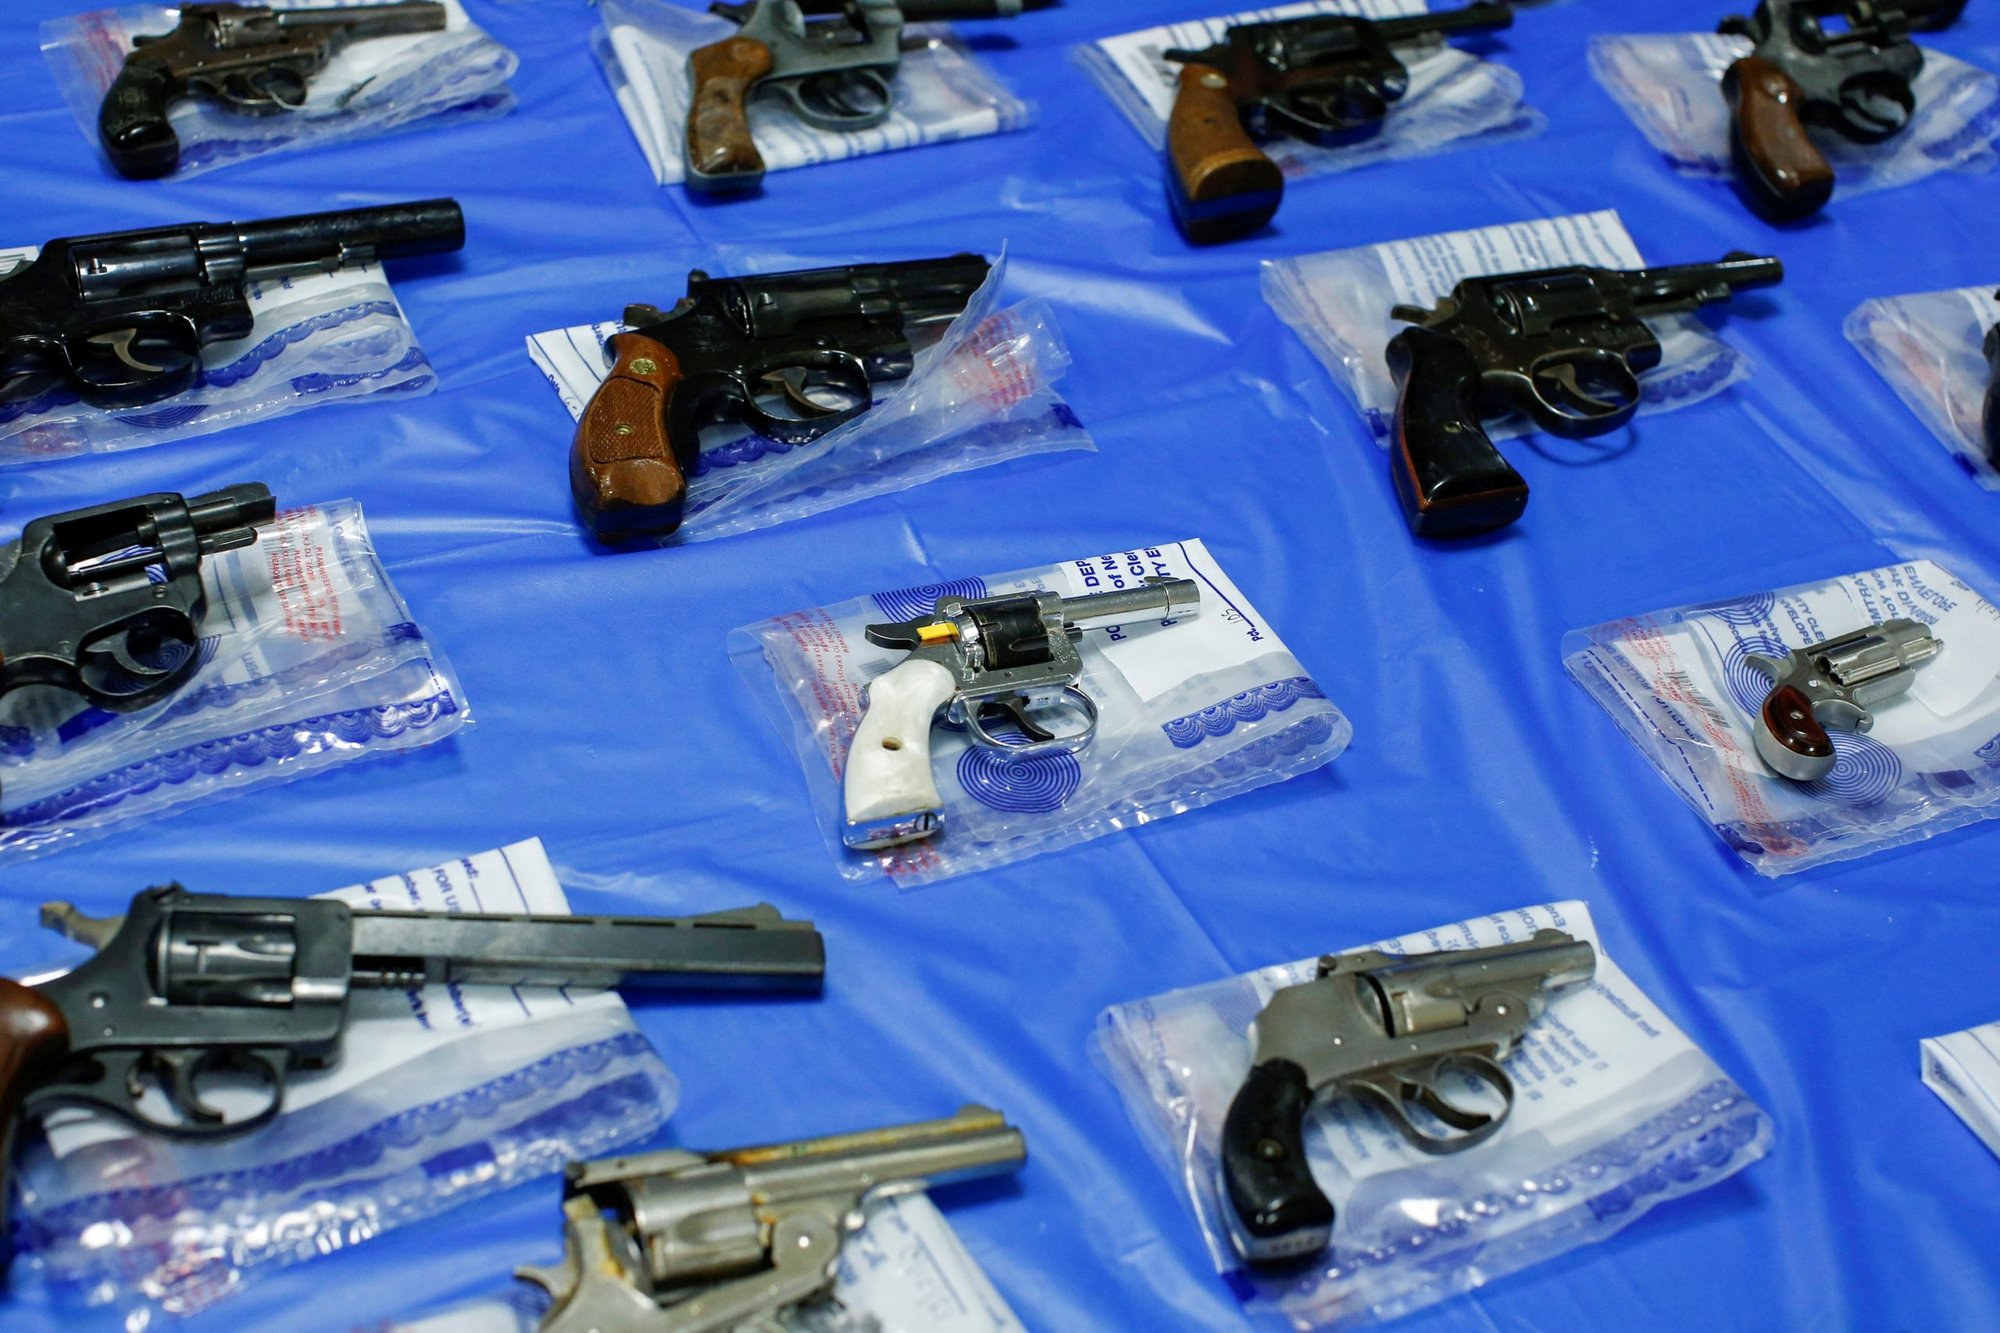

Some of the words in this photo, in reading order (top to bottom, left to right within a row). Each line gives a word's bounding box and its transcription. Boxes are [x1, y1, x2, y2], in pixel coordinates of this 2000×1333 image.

[1108, 574, 1125, 589] of
[836, 655, 847, 682] EXPOSE
[435, 868, 453, 894] FOR
